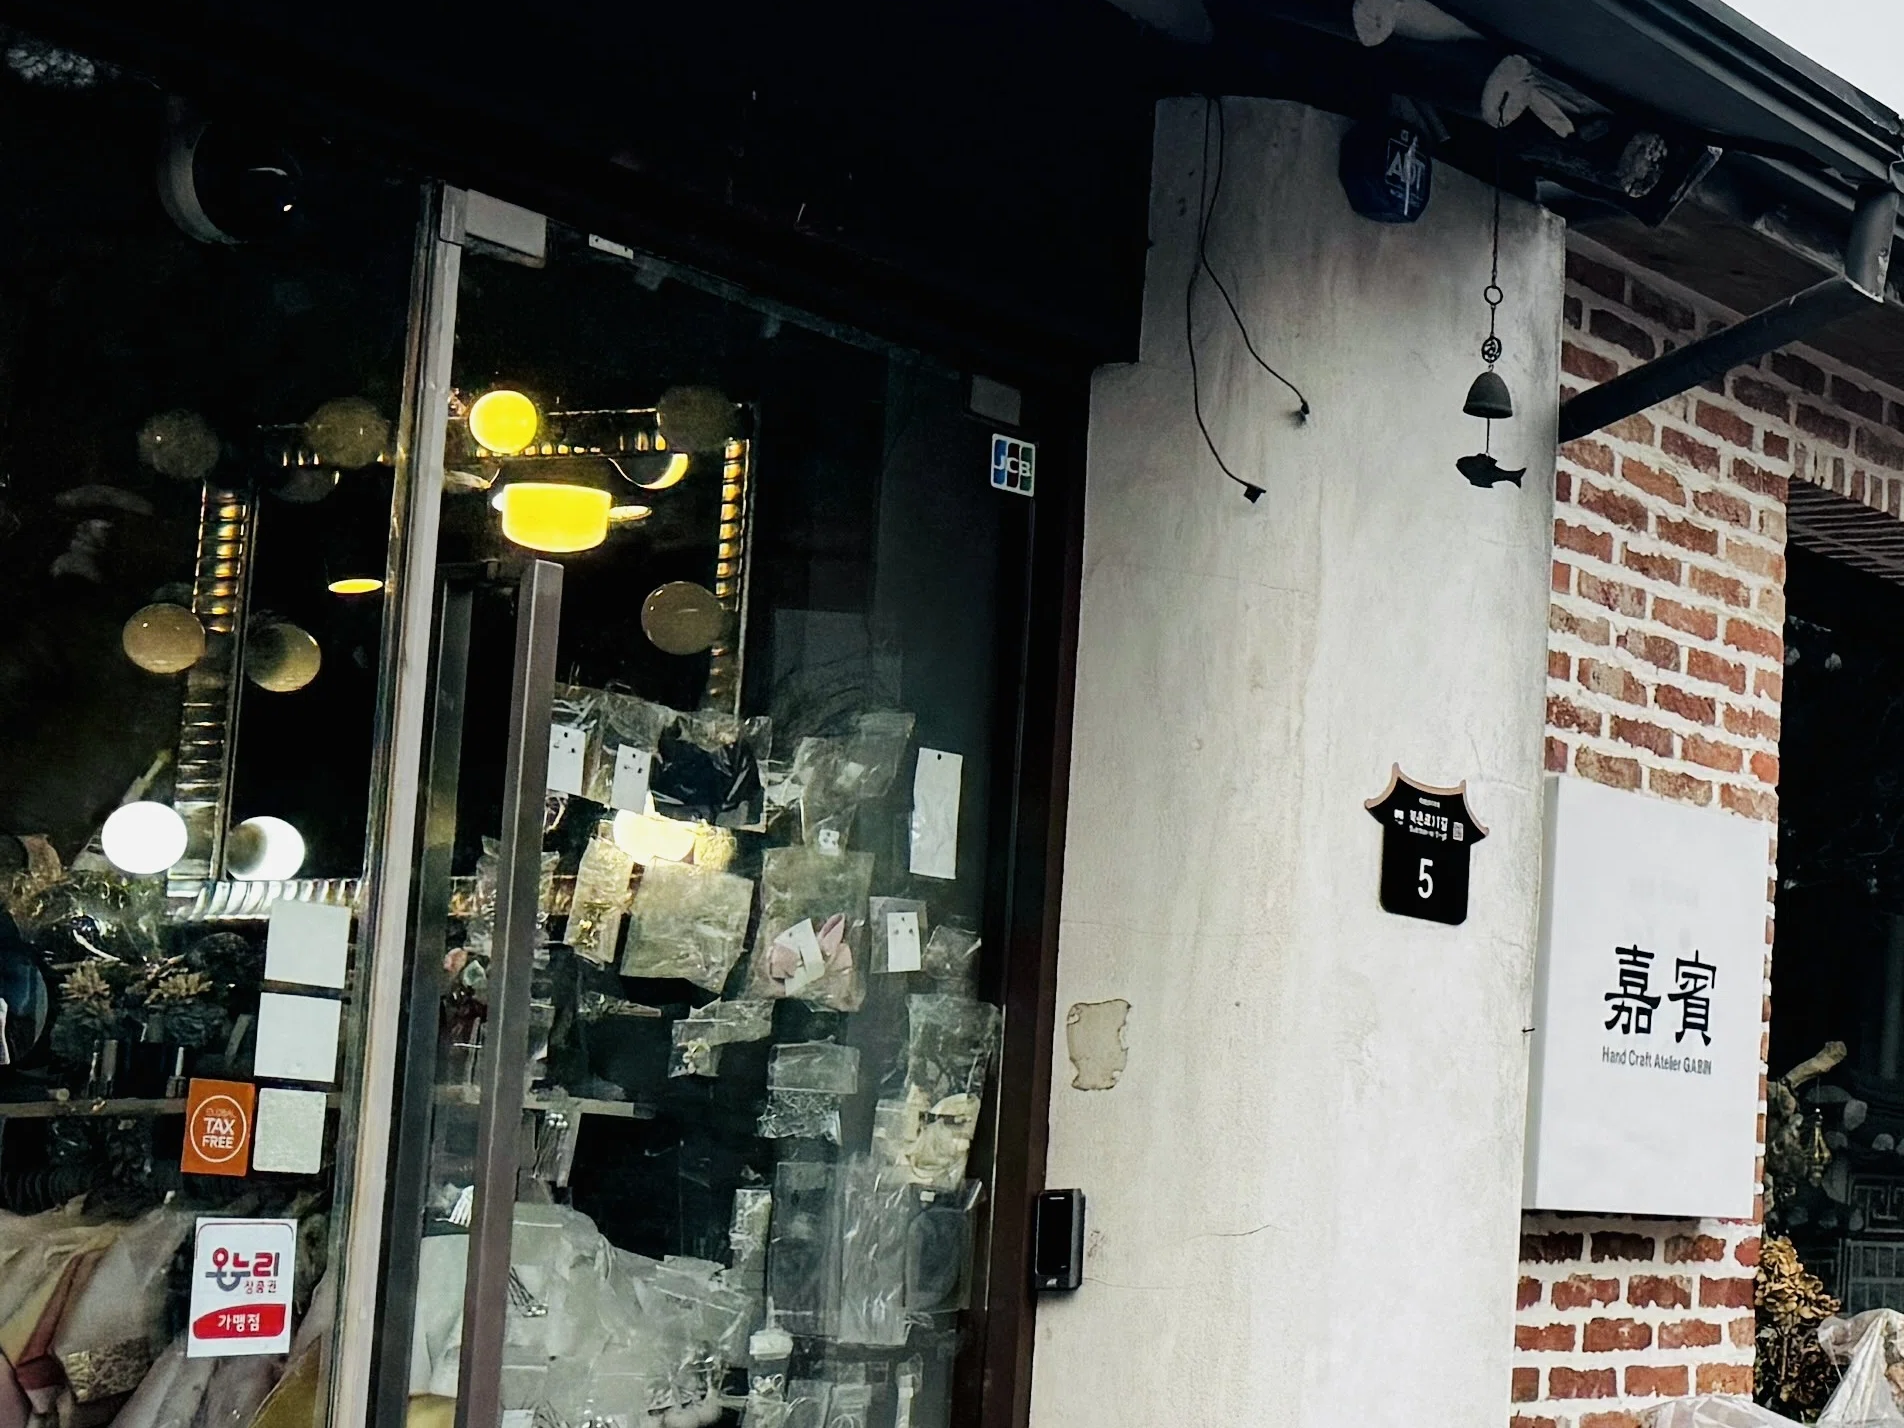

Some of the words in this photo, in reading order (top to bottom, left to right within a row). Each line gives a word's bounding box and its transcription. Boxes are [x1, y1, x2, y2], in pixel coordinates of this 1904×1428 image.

[993, 454, 1031, 478] JCB
[1417, 857, 1434, 899] 5
[1604, 943, 1717, 1047] 嘉賓
[1602, 1045, 1627, 1065] Hand
[1628, 1049, 1653, 1068] Craft
[203, 1117, 235, 1136] TAX
[201, 1135, 234, 1150] FREE
[204, 1247, 280, 1292] 온누리
[217, 1312, 261, 1333] 가맹점
